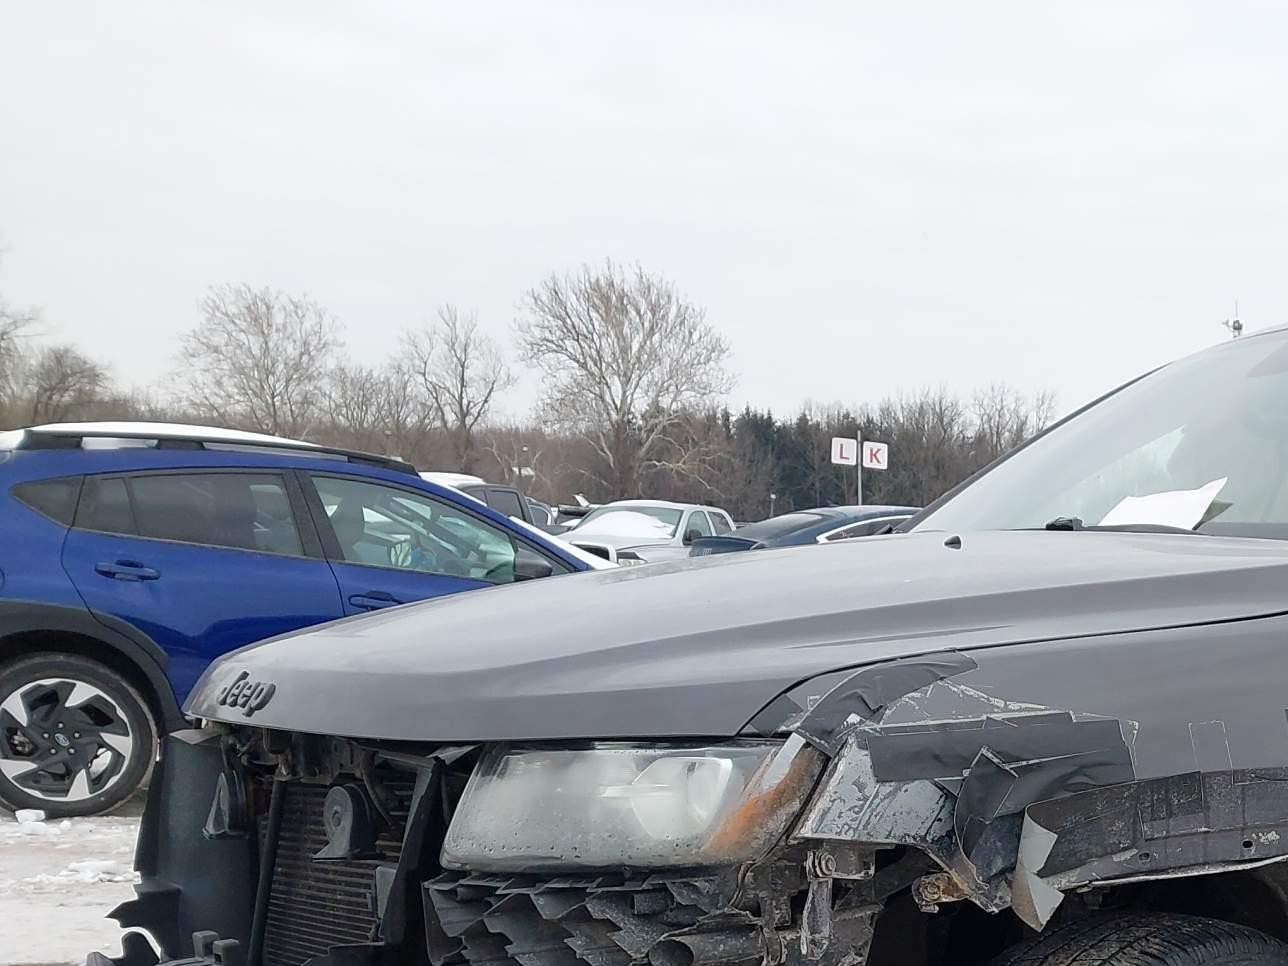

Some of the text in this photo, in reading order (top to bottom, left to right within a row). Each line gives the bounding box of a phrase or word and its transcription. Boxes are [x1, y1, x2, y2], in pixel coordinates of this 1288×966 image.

[839, 443, 850, 460] L
[869, 446, 882, 465] K
[219, 670, 276, 718] Jeep
